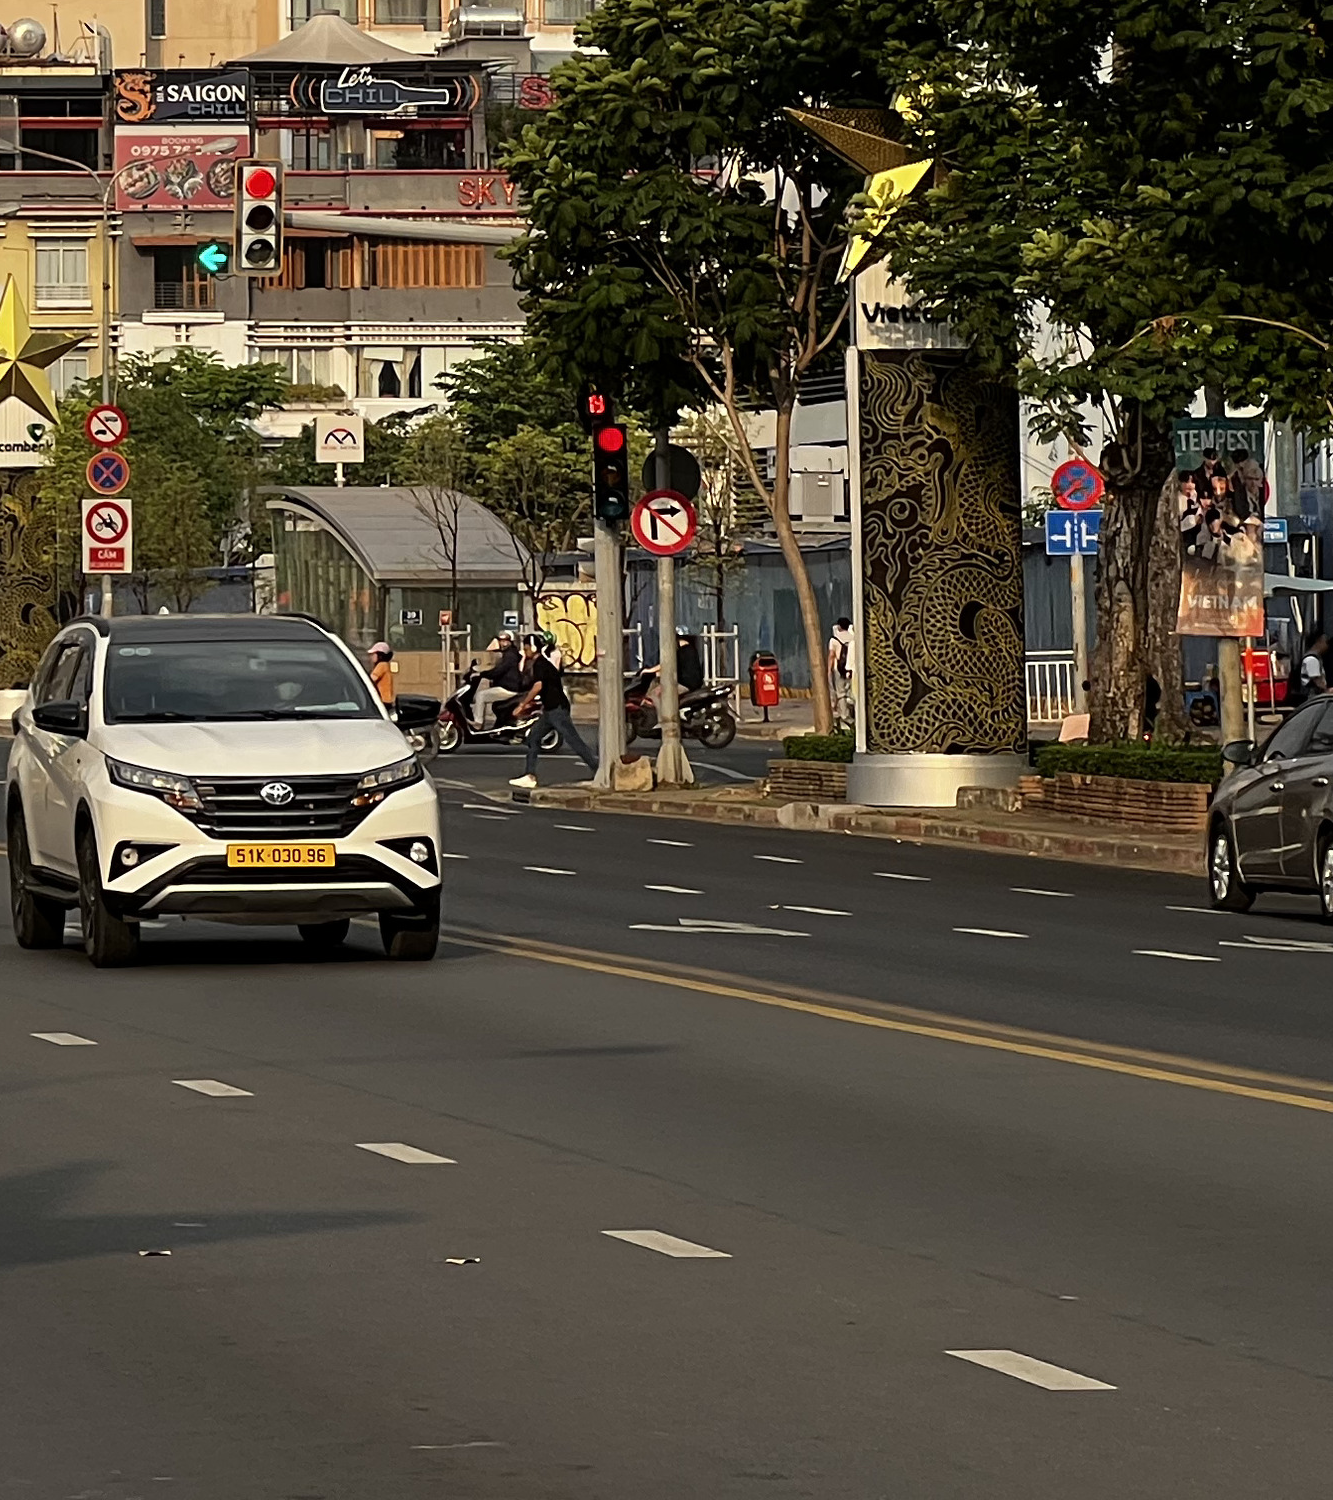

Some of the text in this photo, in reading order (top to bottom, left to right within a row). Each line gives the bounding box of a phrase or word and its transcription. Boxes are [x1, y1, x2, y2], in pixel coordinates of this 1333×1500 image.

[167, 85, 246, 102] SAIGON
[326, 88, 409, 103] CHILL
[188, 103, 246, 115] CHILL
[161, 137, 204, 145] BOOKING
[131, 145, 170, 156] 0975
[1177, 429, 1260, 451] TEMPEST
